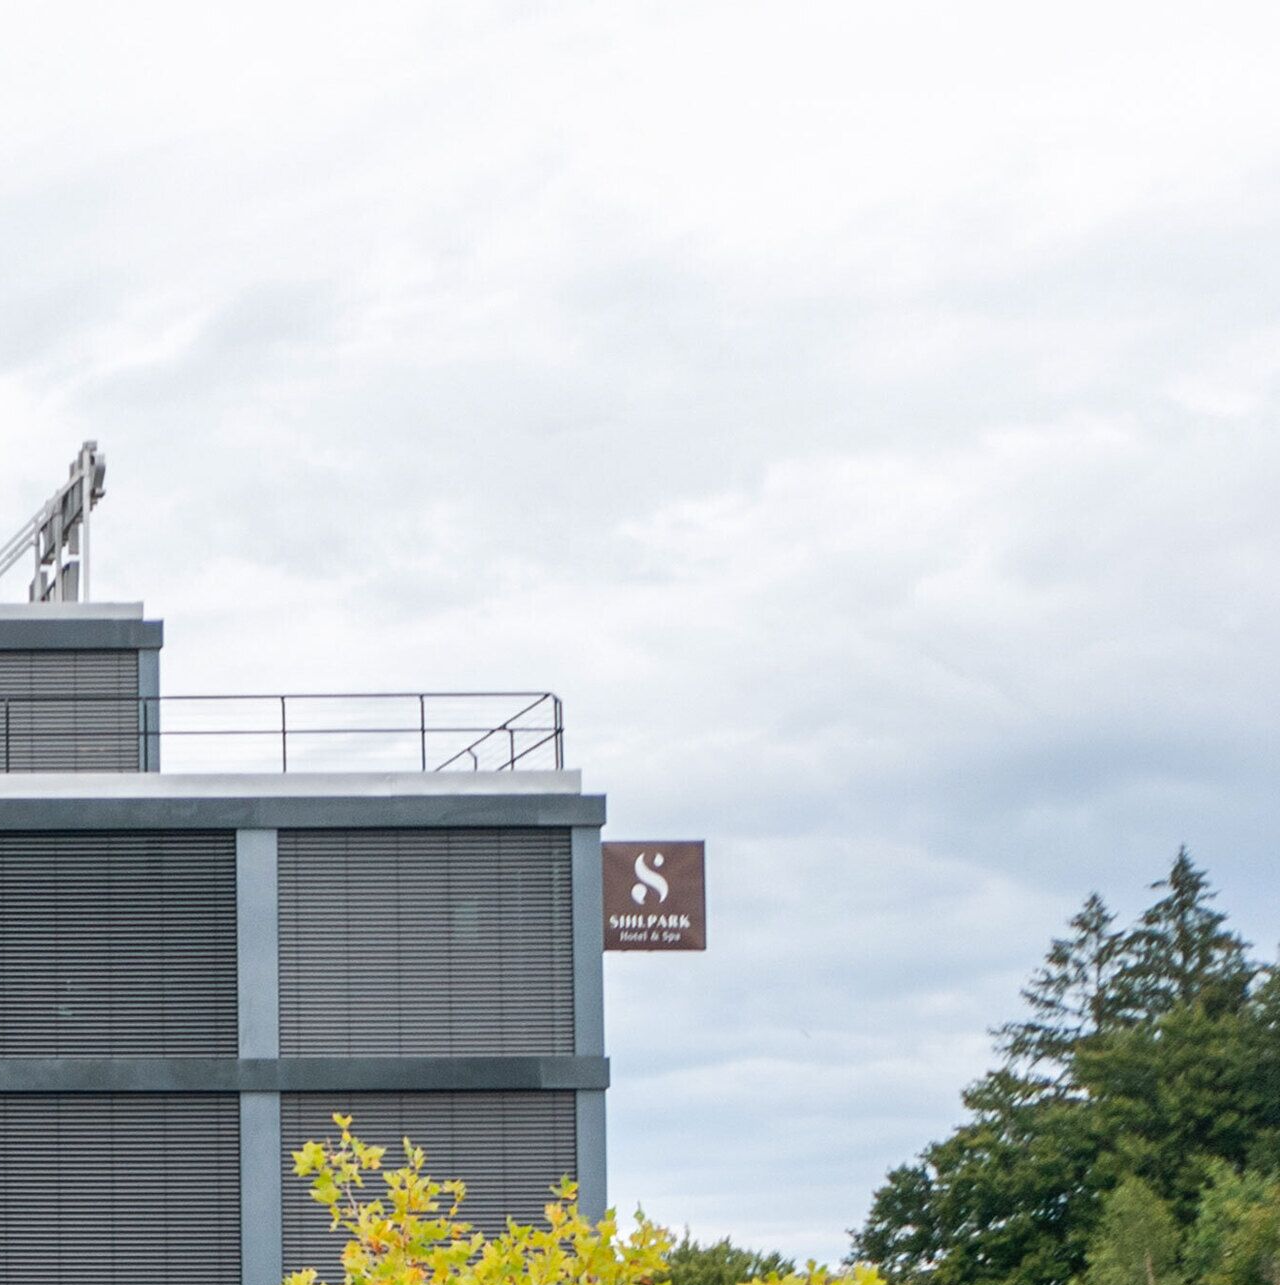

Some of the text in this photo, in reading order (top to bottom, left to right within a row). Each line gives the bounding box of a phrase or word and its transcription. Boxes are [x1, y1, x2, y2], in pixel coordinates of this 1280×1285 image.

[609, 914, 691, 928] SIHLPARK
[620, 931, 648, 942] Hotel
[662, 931, 681, 943] Spa
